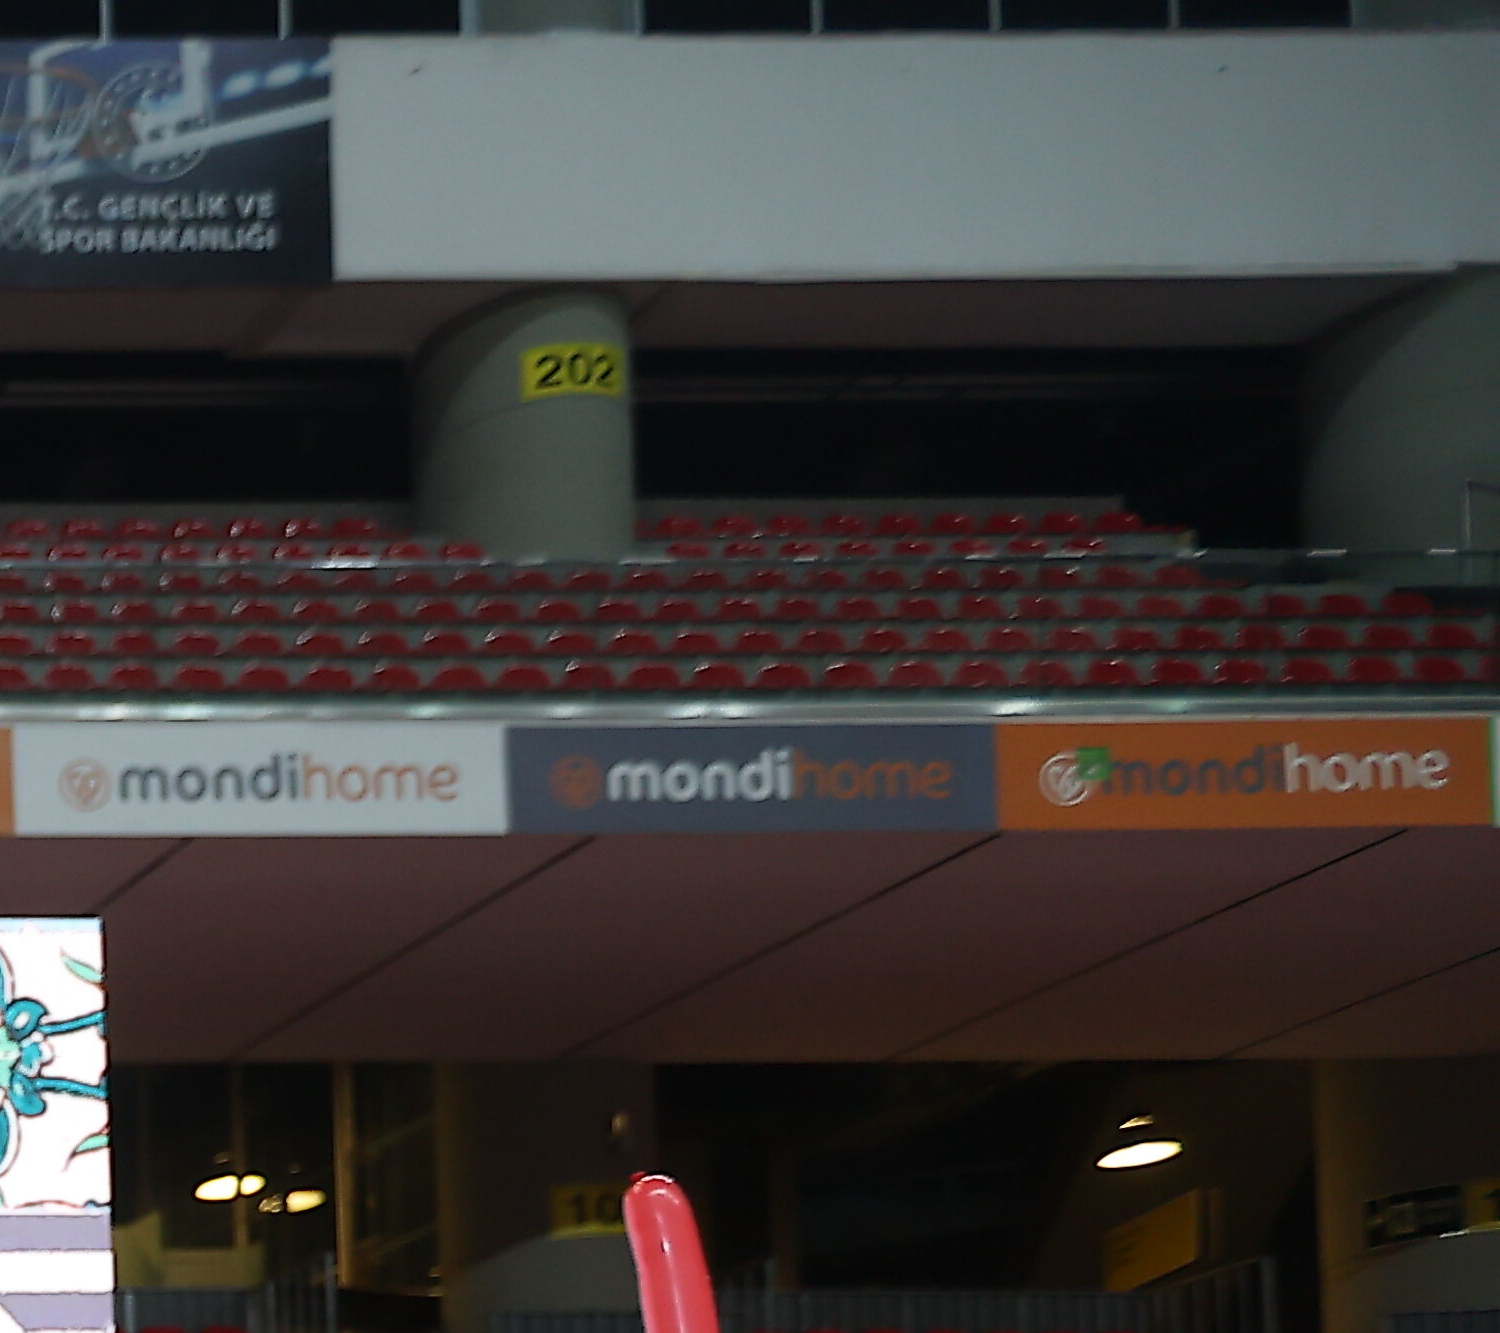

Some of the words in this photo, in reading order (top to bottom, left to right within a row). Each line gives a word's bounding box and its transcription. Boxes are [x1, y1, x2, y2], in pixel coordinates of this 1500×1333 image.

[235, 189, 275, 220] VE
[118, 750, 460, 804] mondihome
[605, 746, 954, 803] mondihome
[1106, 742, 1450, 798] mondihome
